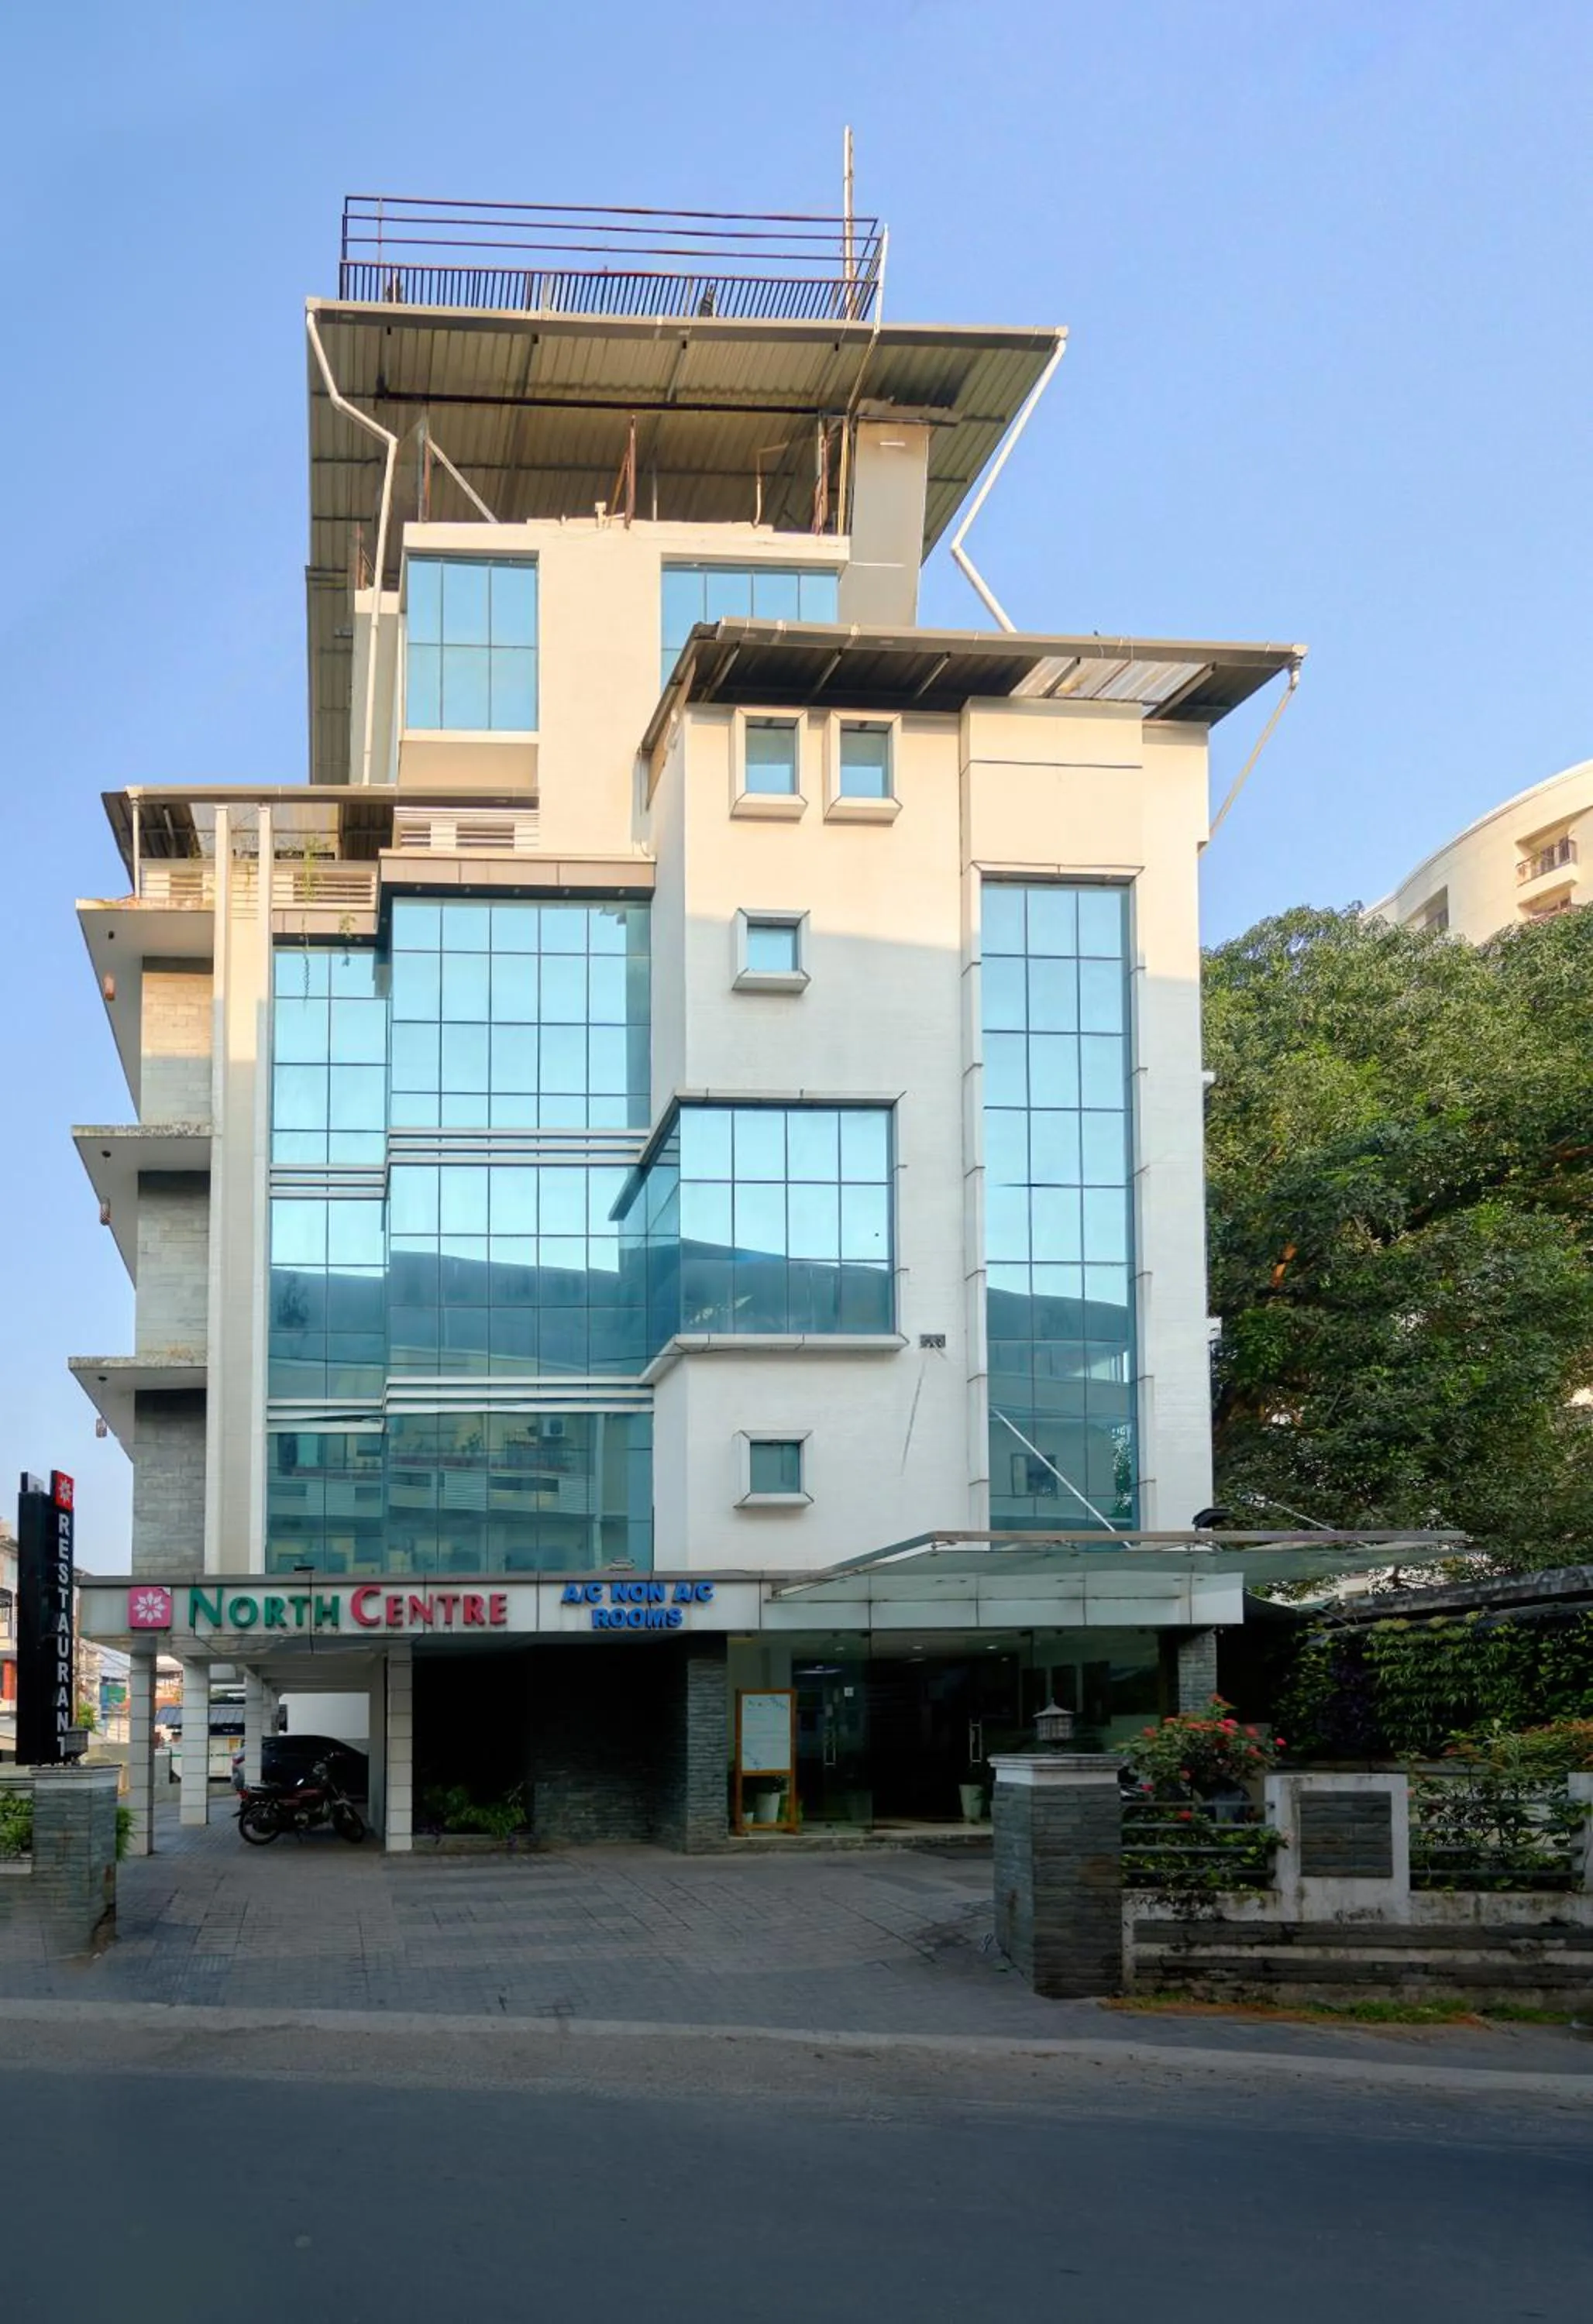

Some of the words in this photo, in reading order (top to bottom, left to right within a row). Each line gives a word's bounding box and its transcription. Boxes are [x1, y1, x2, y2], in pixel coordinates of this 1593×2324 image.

[188, 1585, 341, 1628] NORTH
[350, 1585, 507, 1628] CENTRE
[610, 1582, 666, 1604] NON
[591, 1607, 683, 1629] ROOMS
[57, 1513, 70, 1758] RESTAURANT
